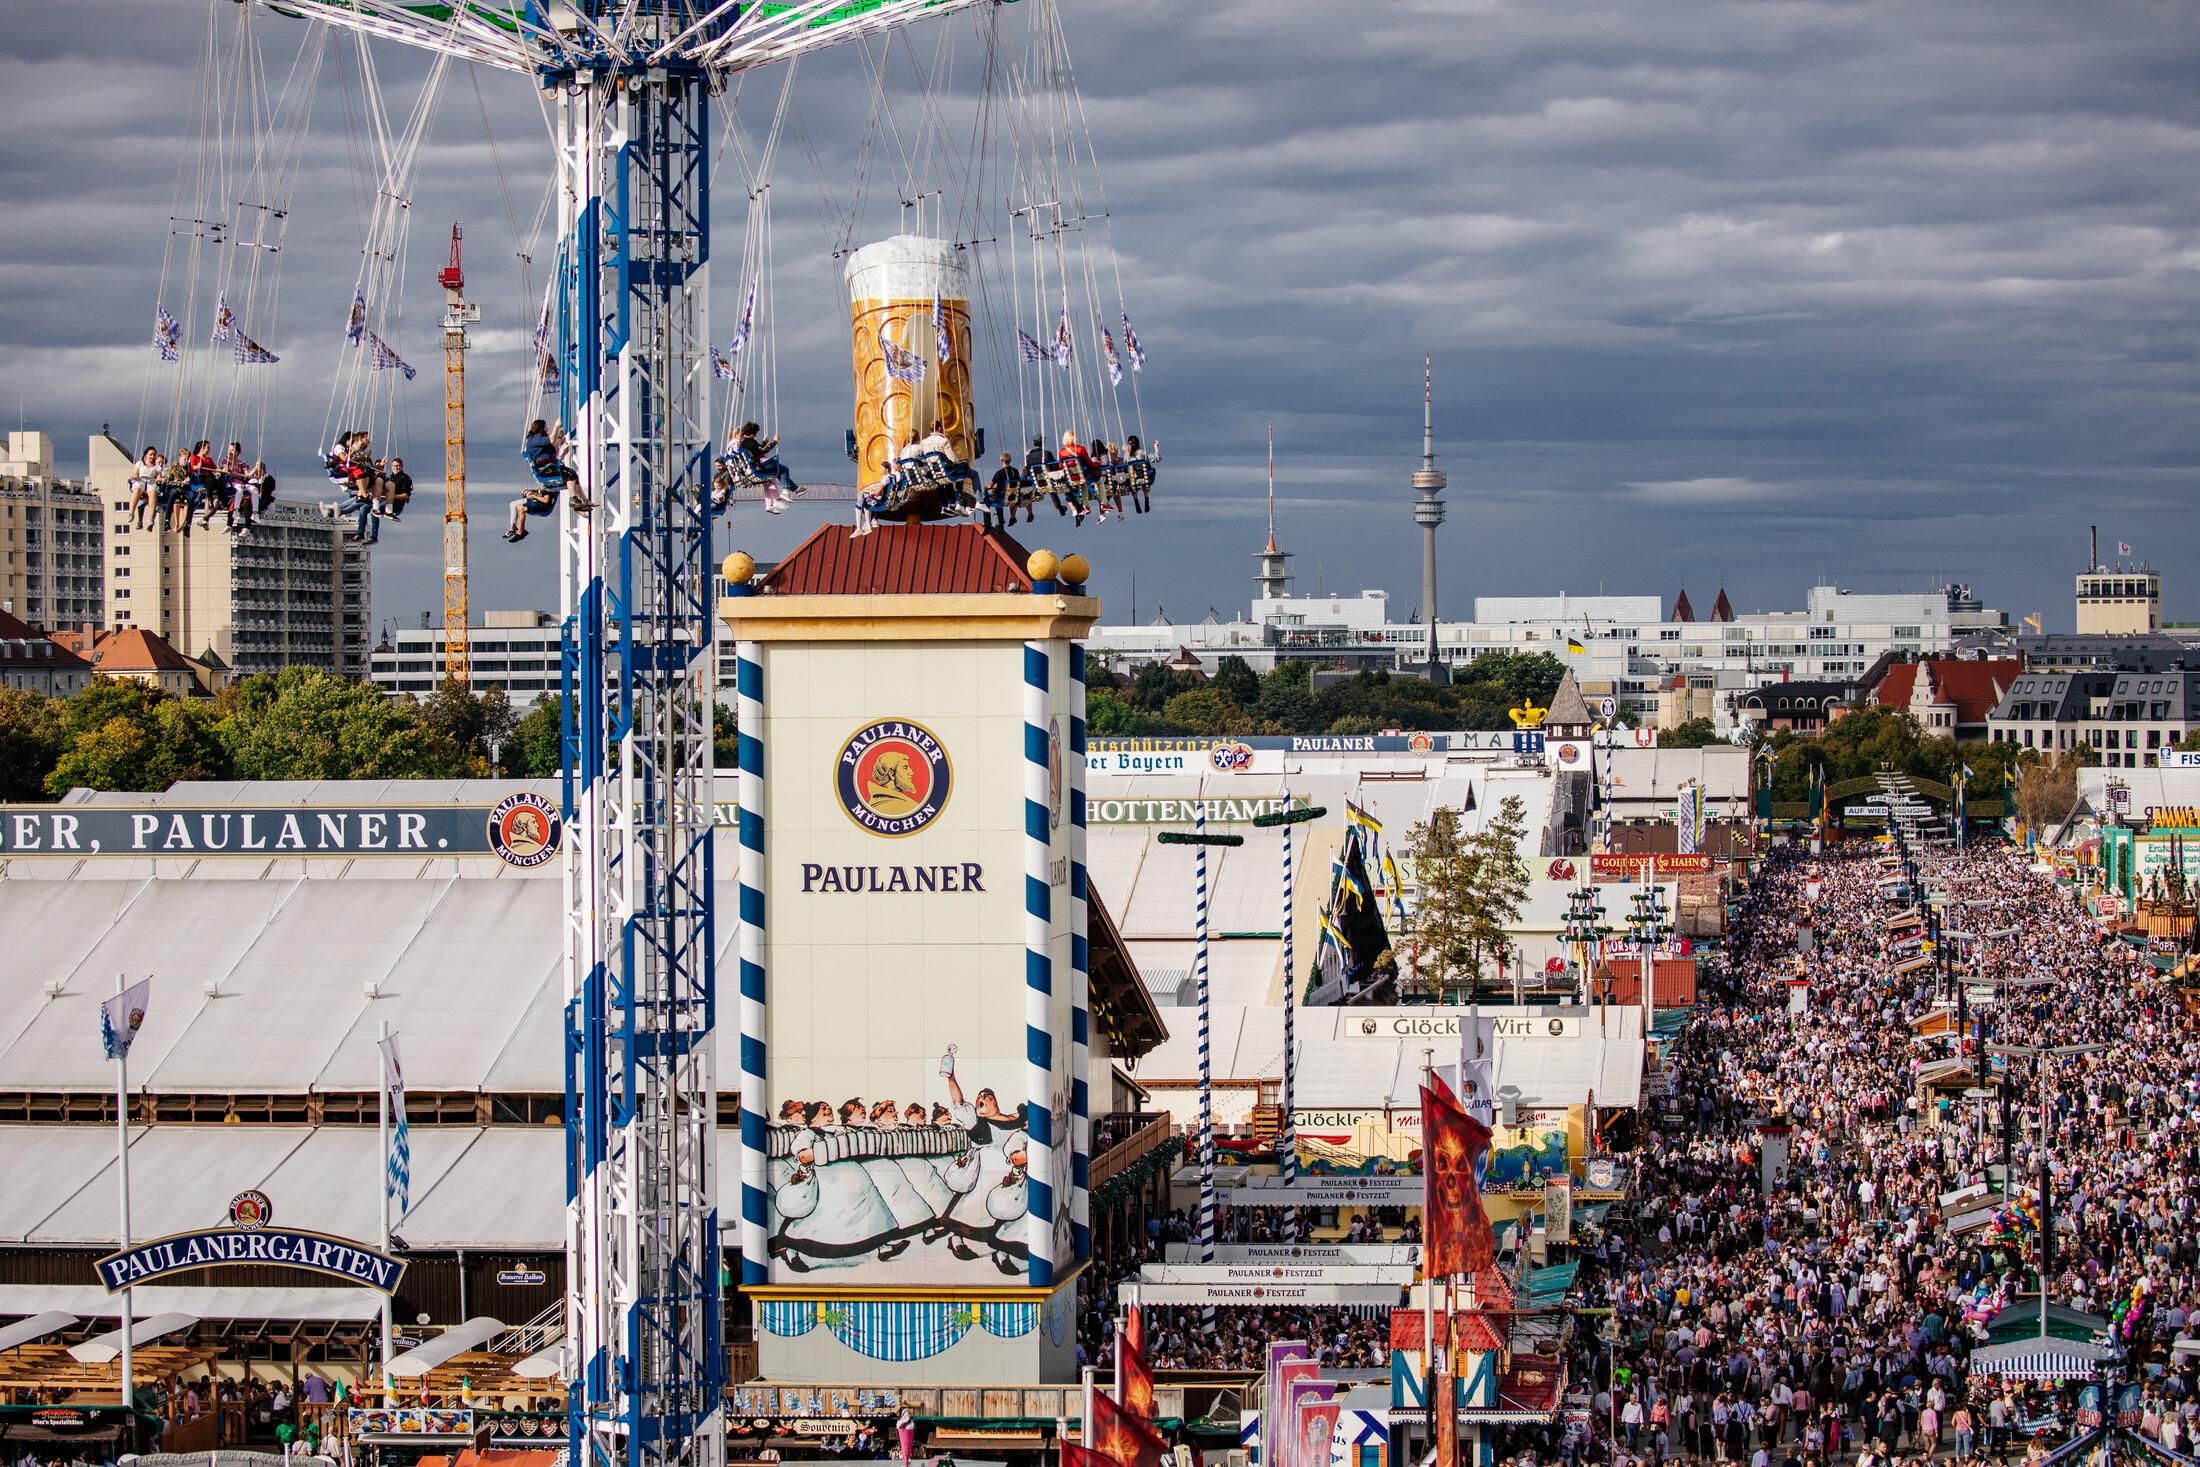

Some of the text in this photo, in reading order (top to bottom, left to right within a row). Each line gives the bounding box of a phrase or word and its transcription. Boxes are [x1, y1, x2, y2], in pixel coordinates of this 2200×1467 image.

[843, 723, 942, 766] PAULANER
[1292, 737, 1375, 751] PAULANER
[1118, 753, 1184, 772] Bayern
[490, 793, 560, 826] PAULANER
[850, 803, 937, 833] MÜNCHEN
[0, 814, 448, 855] ER, PAULANER.
[495, 844, 556, 867] MÜNCHEN
[1671, 858, 1699, 867] HAHN
[801, 863, 986, 893] PAULANER
[1516, 1112, 1546, 1124] Essen
[231, 1193, 266, 1210] PAULANER
[233, 1219, 264, 1230] MÜNCHEN
[108, 1234, 393, 1286] PAULANERGARTEN
[1248, 1249, 1340, 1257] PAULANER FESTZELT
[1228, 1269, 1324, 1277] PAULANER FESTZELT
[1207, 1289, 1306, 1297] PAULANER FESTZELT
[800, 1421, 851, 1432] Souvenirs
[2077, 1408, 2102, 1427] SHOP
[2117, 1408, 2142, 1427] SHOP
